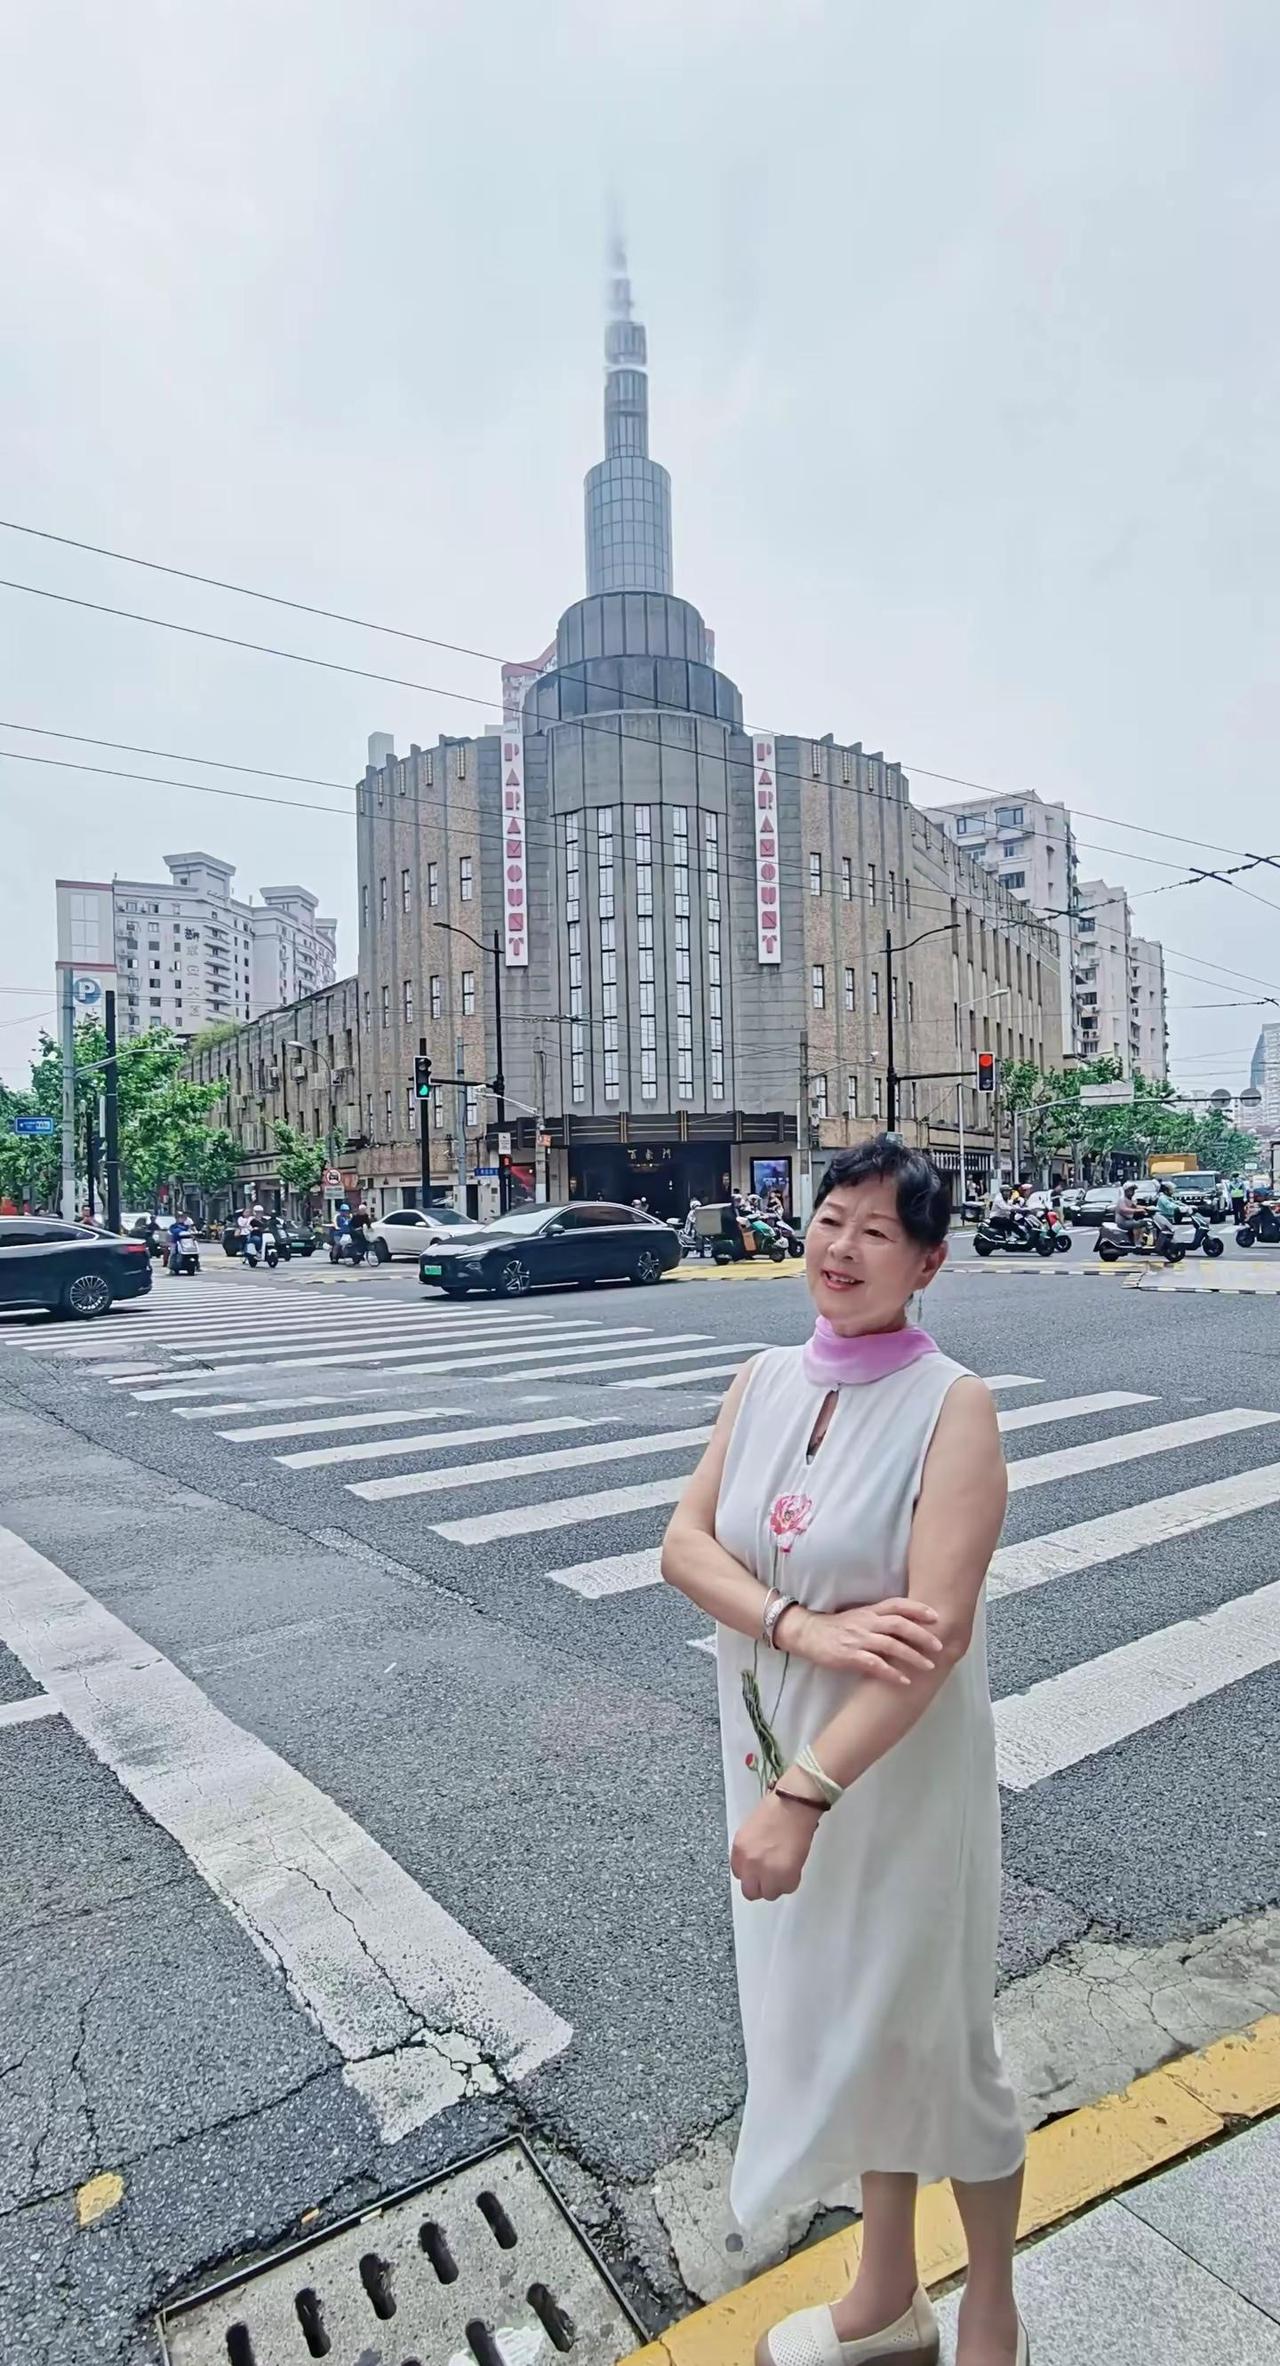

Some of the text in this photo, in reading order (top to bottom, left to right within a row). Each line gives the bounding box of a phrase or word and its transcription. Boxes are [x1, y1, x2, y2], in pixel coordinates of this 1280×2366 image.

[504, 743, 524, 956] PARAMOUNT
[757, 743, 778, 953] PARAMOUNT
[79, 981, 96, 1000] P
